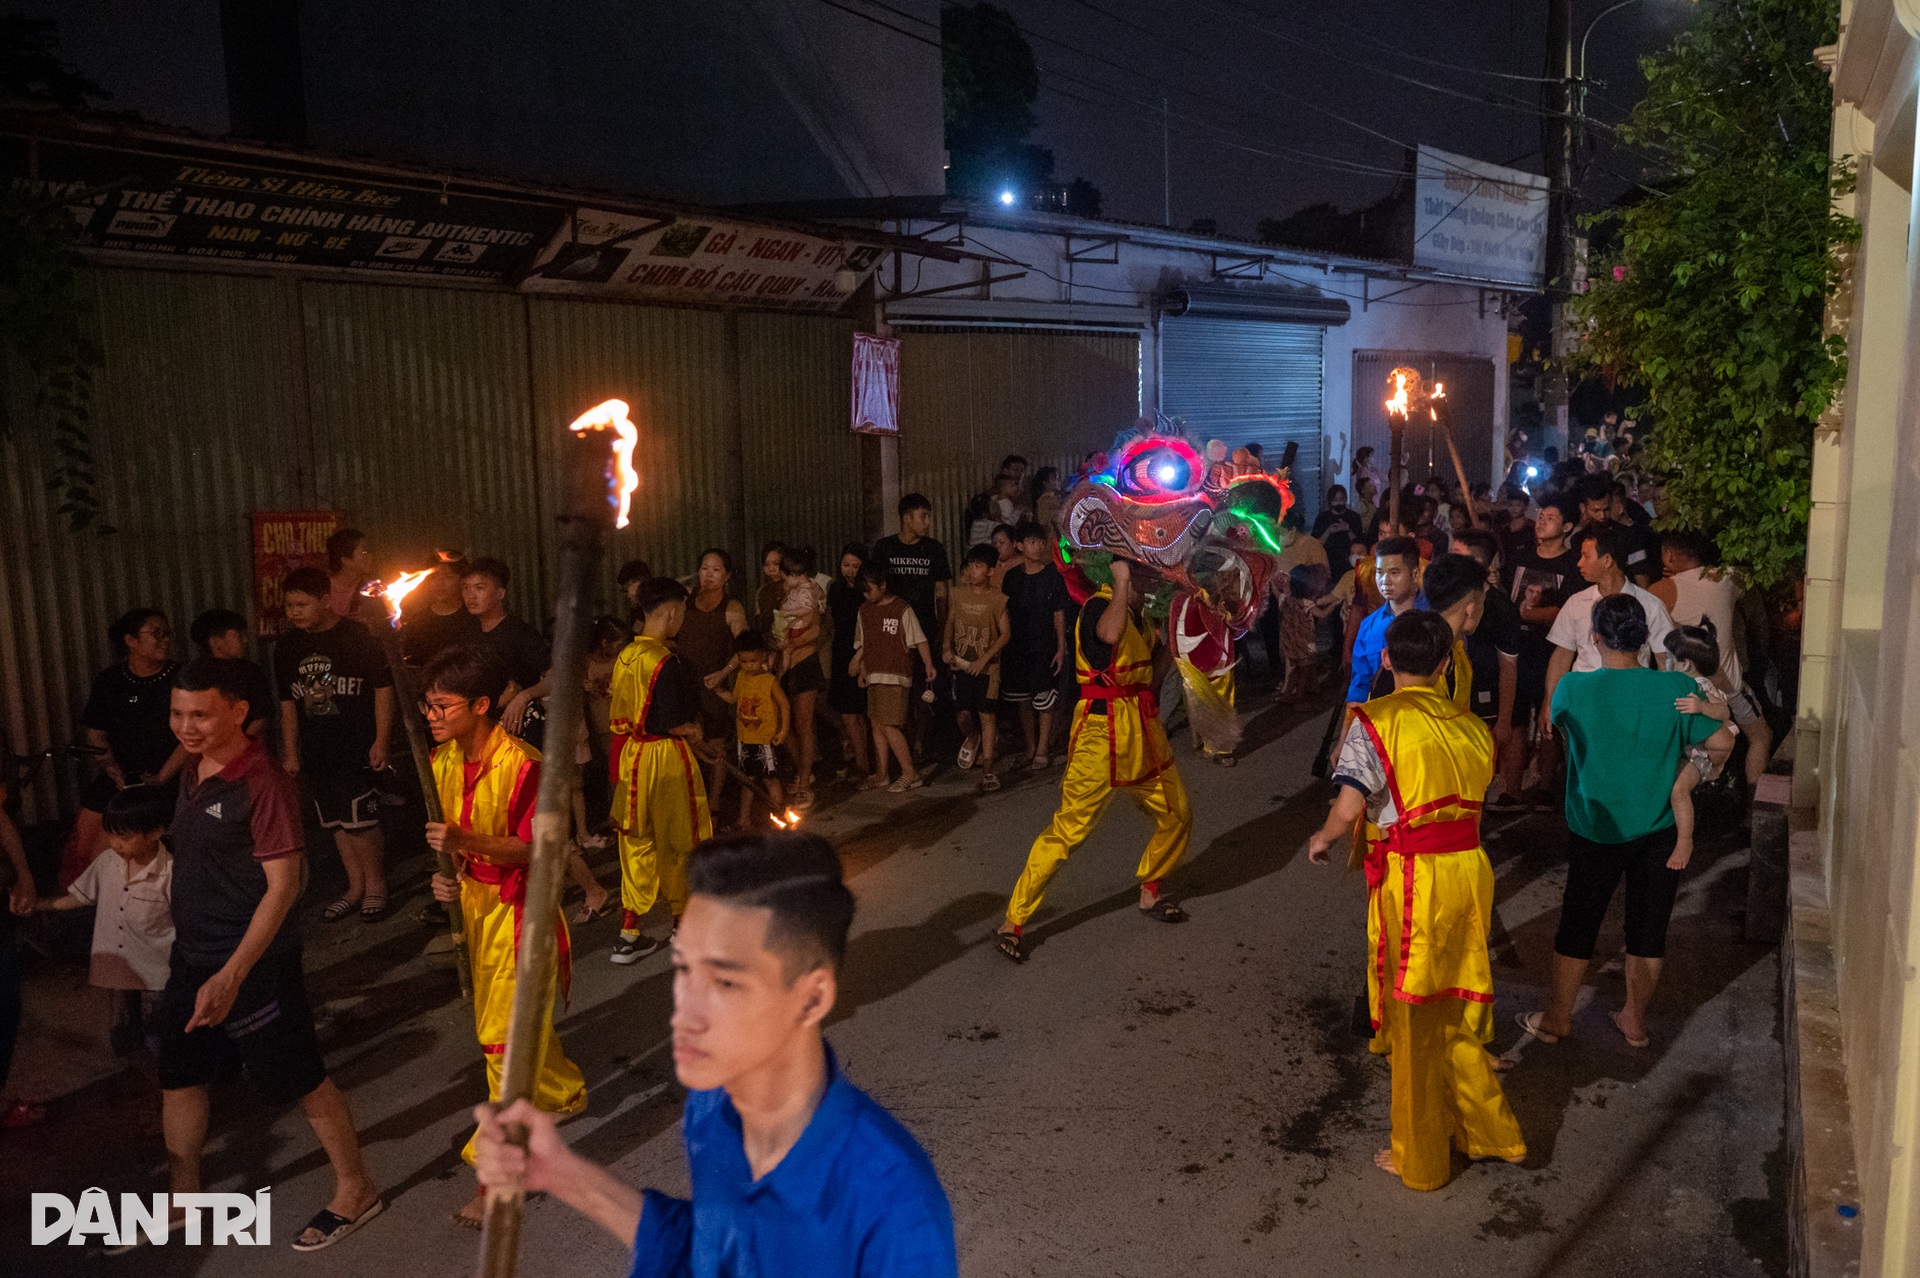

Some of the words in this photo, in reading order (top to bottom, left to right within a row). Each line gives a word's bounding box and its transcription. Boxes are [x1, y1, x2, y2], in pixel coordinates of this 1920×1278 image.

[182, 196, 256, 220] THAO
[259, 205, 346, 230] CHÍNH
[416, 222, 535, 247] AUTHENTIC
[207, 225, 262, 243] NAM
[704, 229, 739, 255] GÀ
[746, 237, 807, 262] NGAN
[813, 244, 844, 269] VỊT
[626, 262, 690, 287] CHIM
[715, 268, 761, 292] CÂU
[755, 275, 808, 296] QUAY
[262, 521, 294, 555] CHO
[889, 557, 931, 566] MIKENCO
[889, 566, 930, 576] COUTURE
